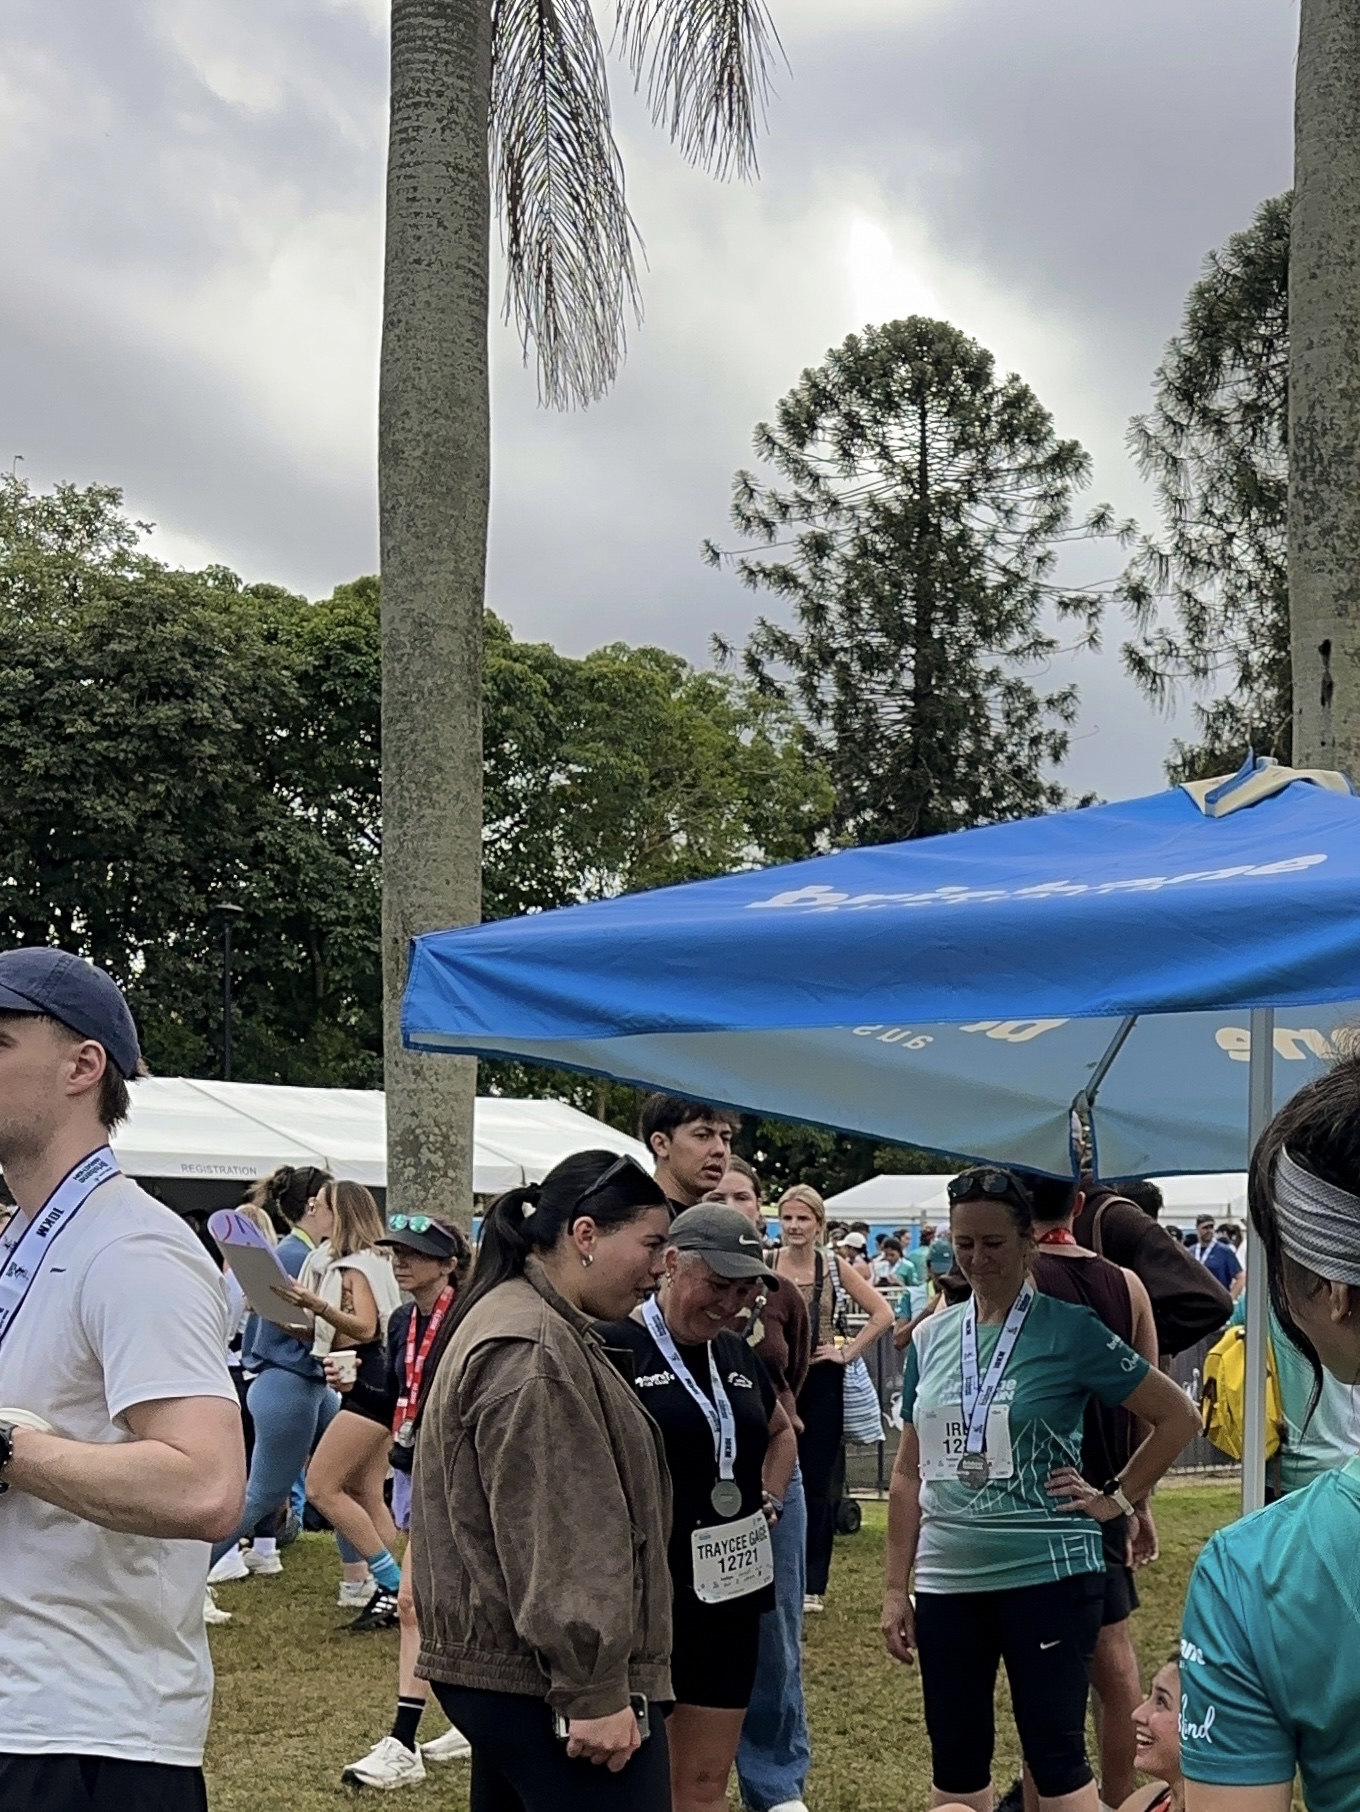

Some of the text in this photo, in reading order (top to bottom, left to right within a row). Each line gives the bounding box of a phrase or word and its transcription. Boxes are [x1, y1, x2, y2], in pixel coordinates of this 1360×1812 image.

[181, 1163, 258, 1176] REGISTRATION
[36, 1206, 65, 1239] 10KM
[697, 1534, 748, 1560] TRAYCEE
[718, 1547, 758, 1573] 12721
